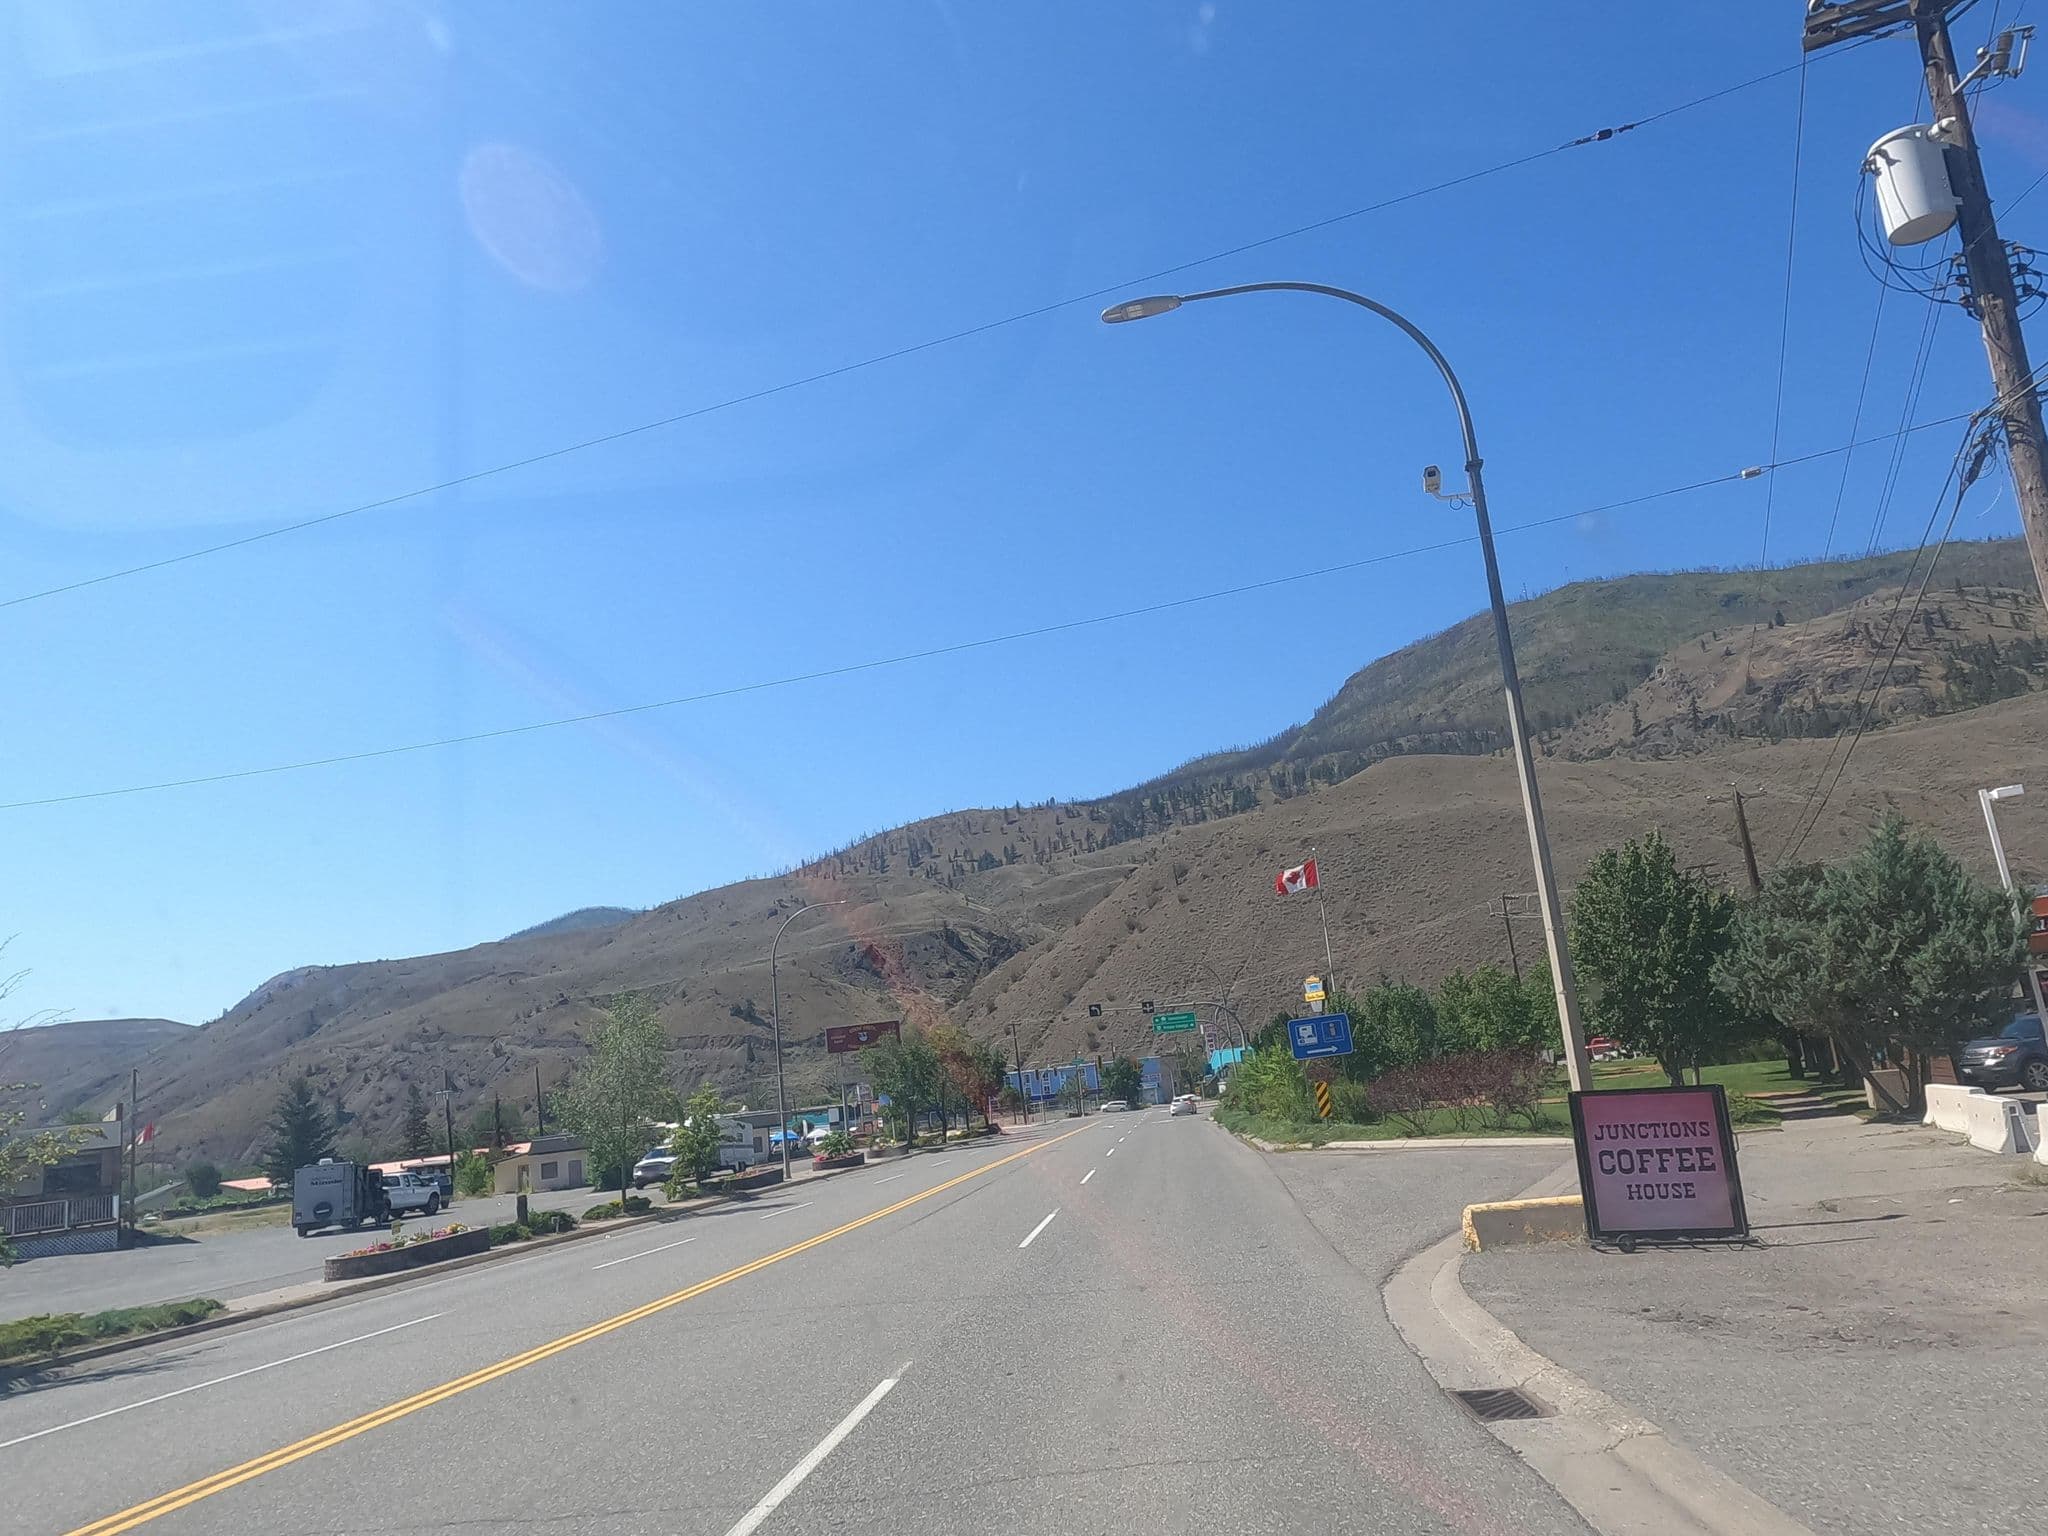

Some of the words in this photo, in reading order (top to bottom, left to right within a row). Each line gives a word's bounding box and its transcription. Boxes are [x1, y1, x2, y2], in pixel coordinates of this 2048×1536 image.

[1594, 1121, 1711, 1141] JUNCTIONS
[1598, 1146, 1717, 1175] COFFEE
[1626, 1182, 1697, 1201] HOUSE
